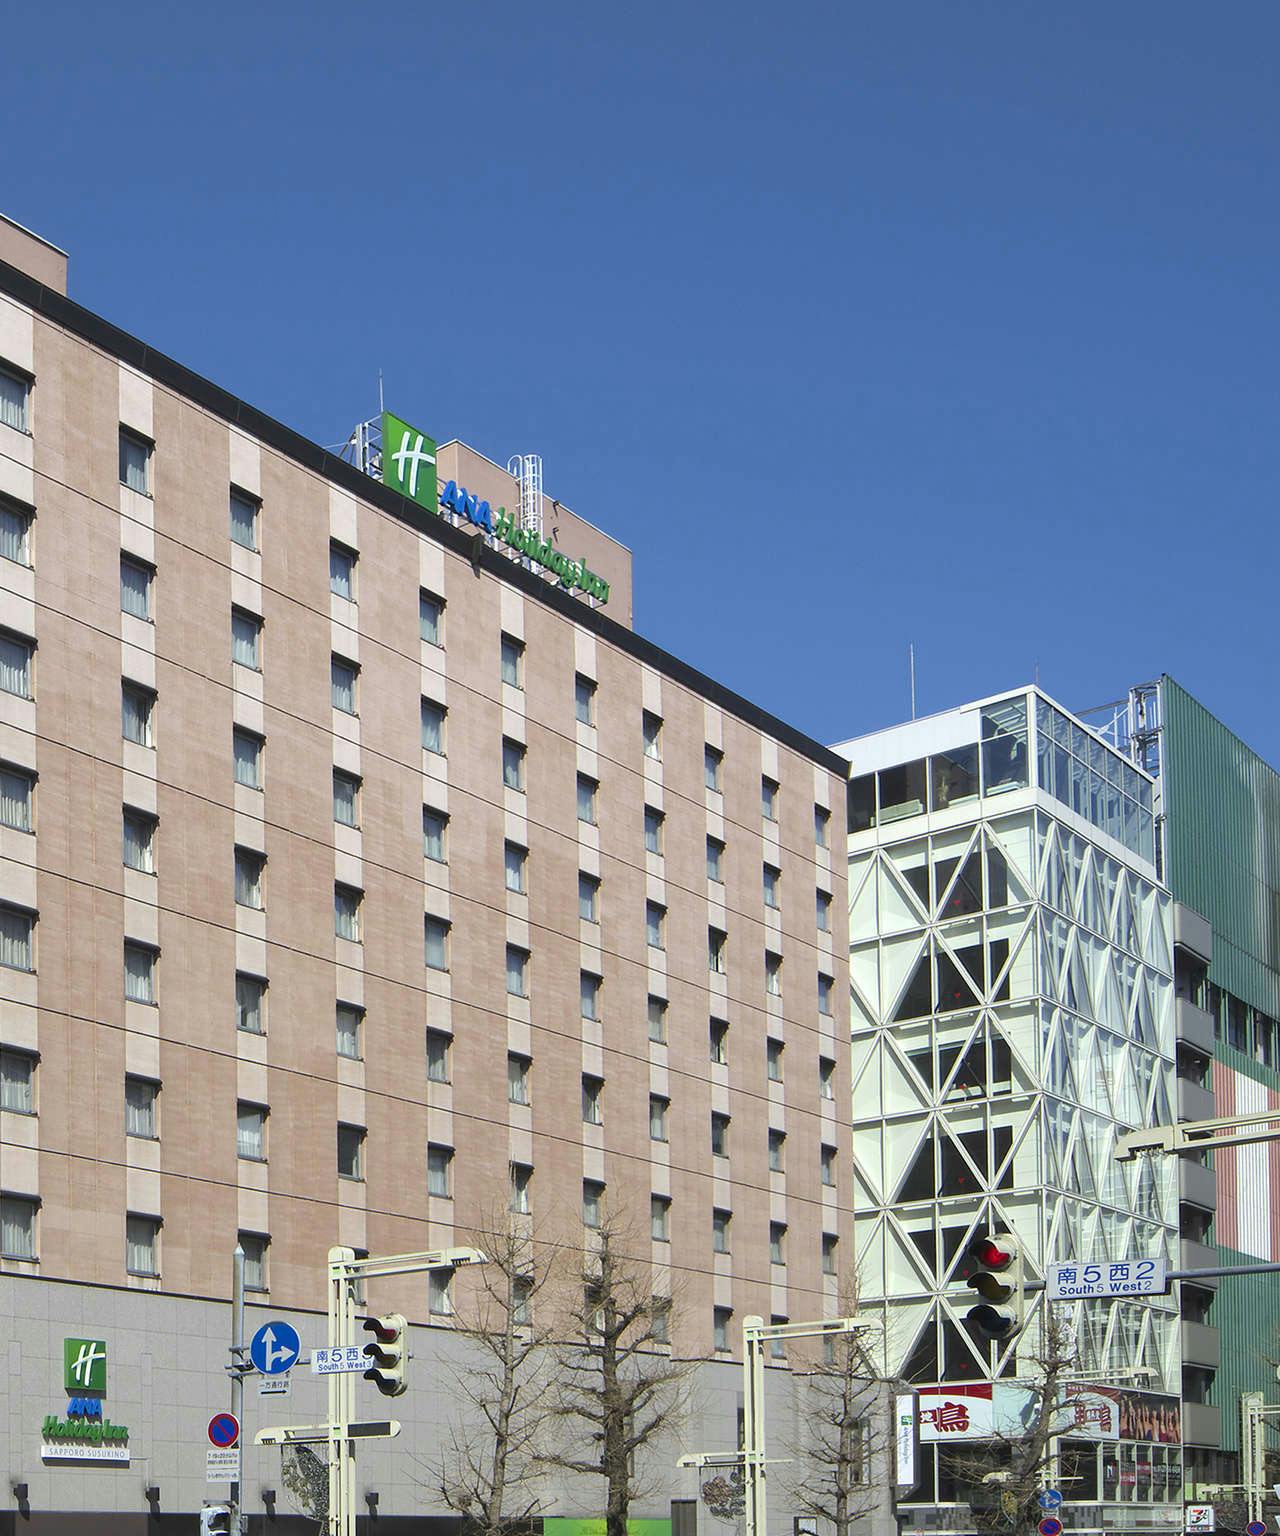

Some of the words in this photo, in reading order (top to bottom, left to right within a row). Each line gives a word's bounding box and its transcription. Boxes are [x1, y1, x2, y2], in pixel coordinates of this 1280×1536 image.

[440, 480, 493, 532] ANA
[493, 507, 577, 588] Holiday
[575, 557, 609, 604] Inn
[1057, 1261, 1156, 1285] 南5西2
[1059, 1285, 1095, 1296] South
[1096, 1284, 1105, 1293] 5
[1110, 1281, 1142, 1292] West
[1144, 1280, 1153, 1291] 2
[318, 1363, 339, 1371] South
[347, 1361, 366, 1369] West
[67, 1397, 103, 1416] ANA
[41, 1415, 103, 1442] Holiday
[103, 1418, 130, 1440] Inn
[48, 1447, 85, 1456] SAPPORO
[87, 1449, 126, 1458] SUSUKINO
